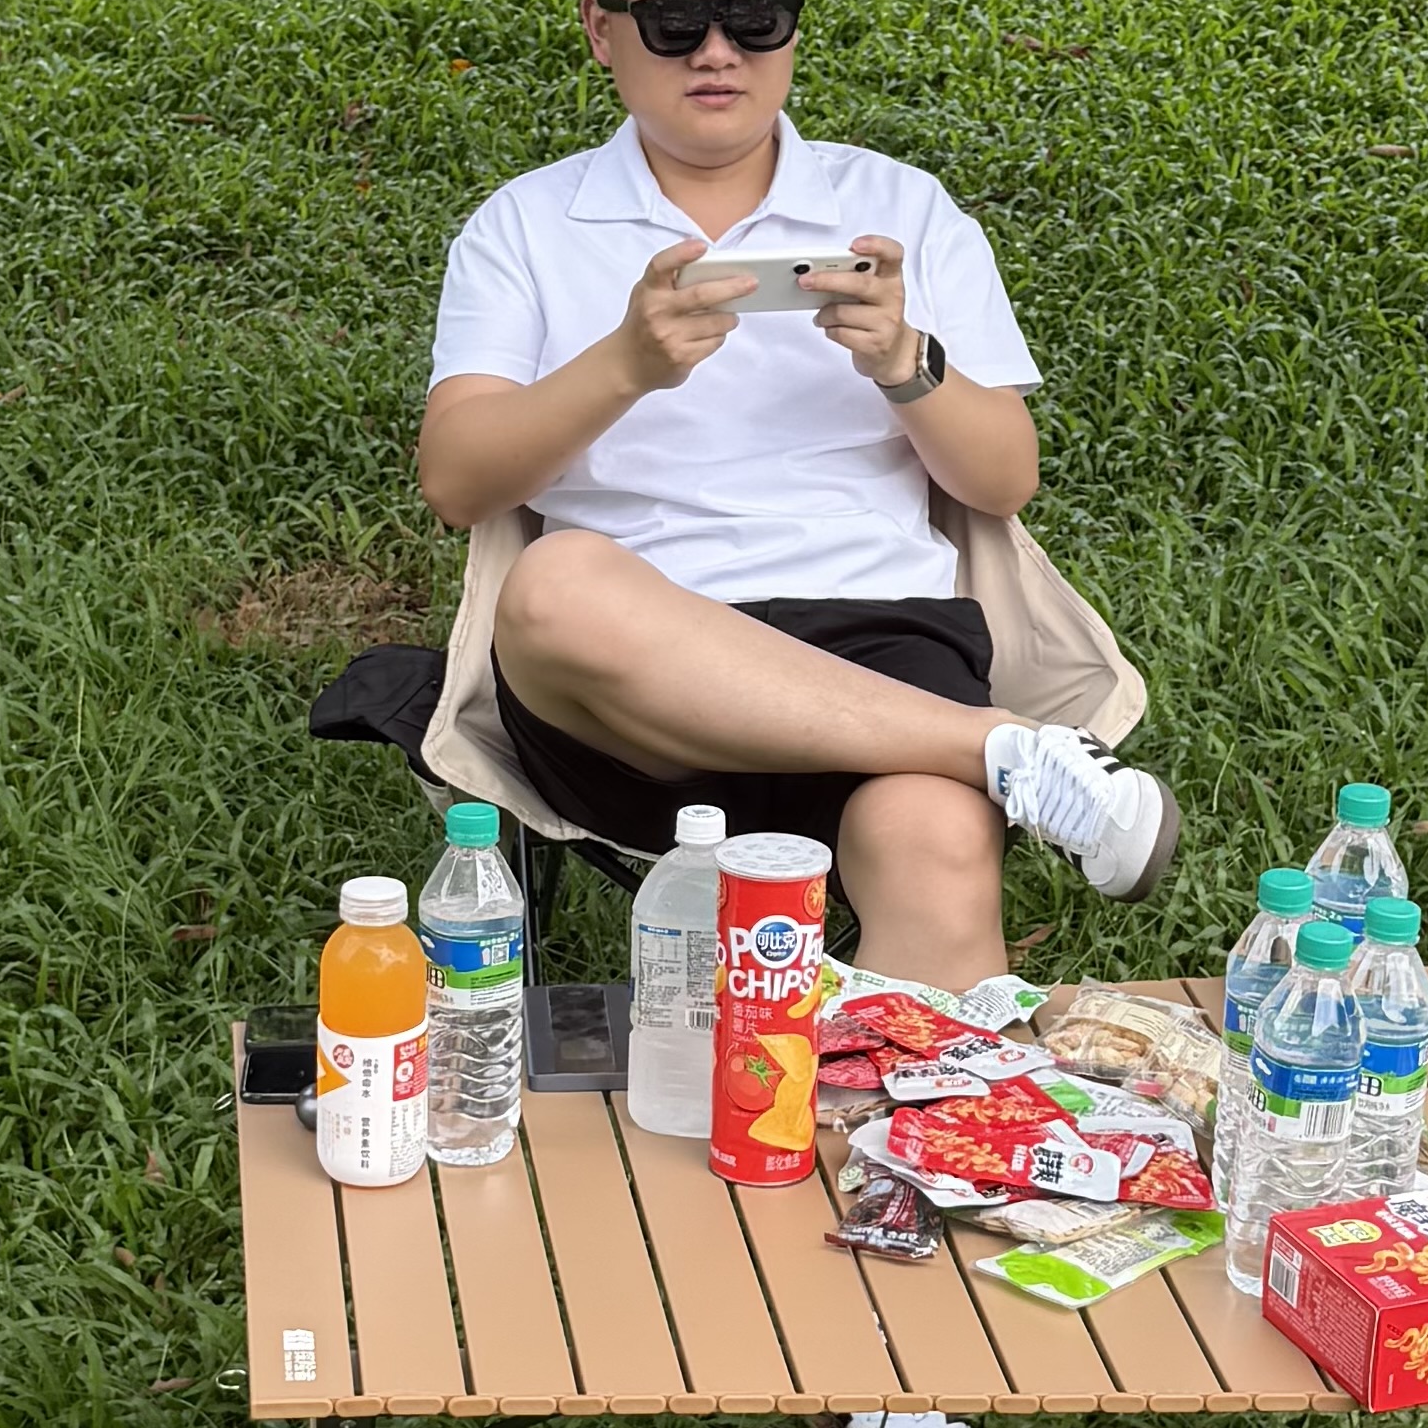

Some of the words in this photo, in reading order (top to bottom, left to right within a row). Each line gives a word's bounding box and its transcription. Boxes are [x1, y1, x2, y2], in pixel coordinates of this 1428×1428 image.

[757, 931, 797, 951] 可比克
[728, 966, 816, 1002] CHIPS
[732, 1002, 774, 1020] 番茄味
